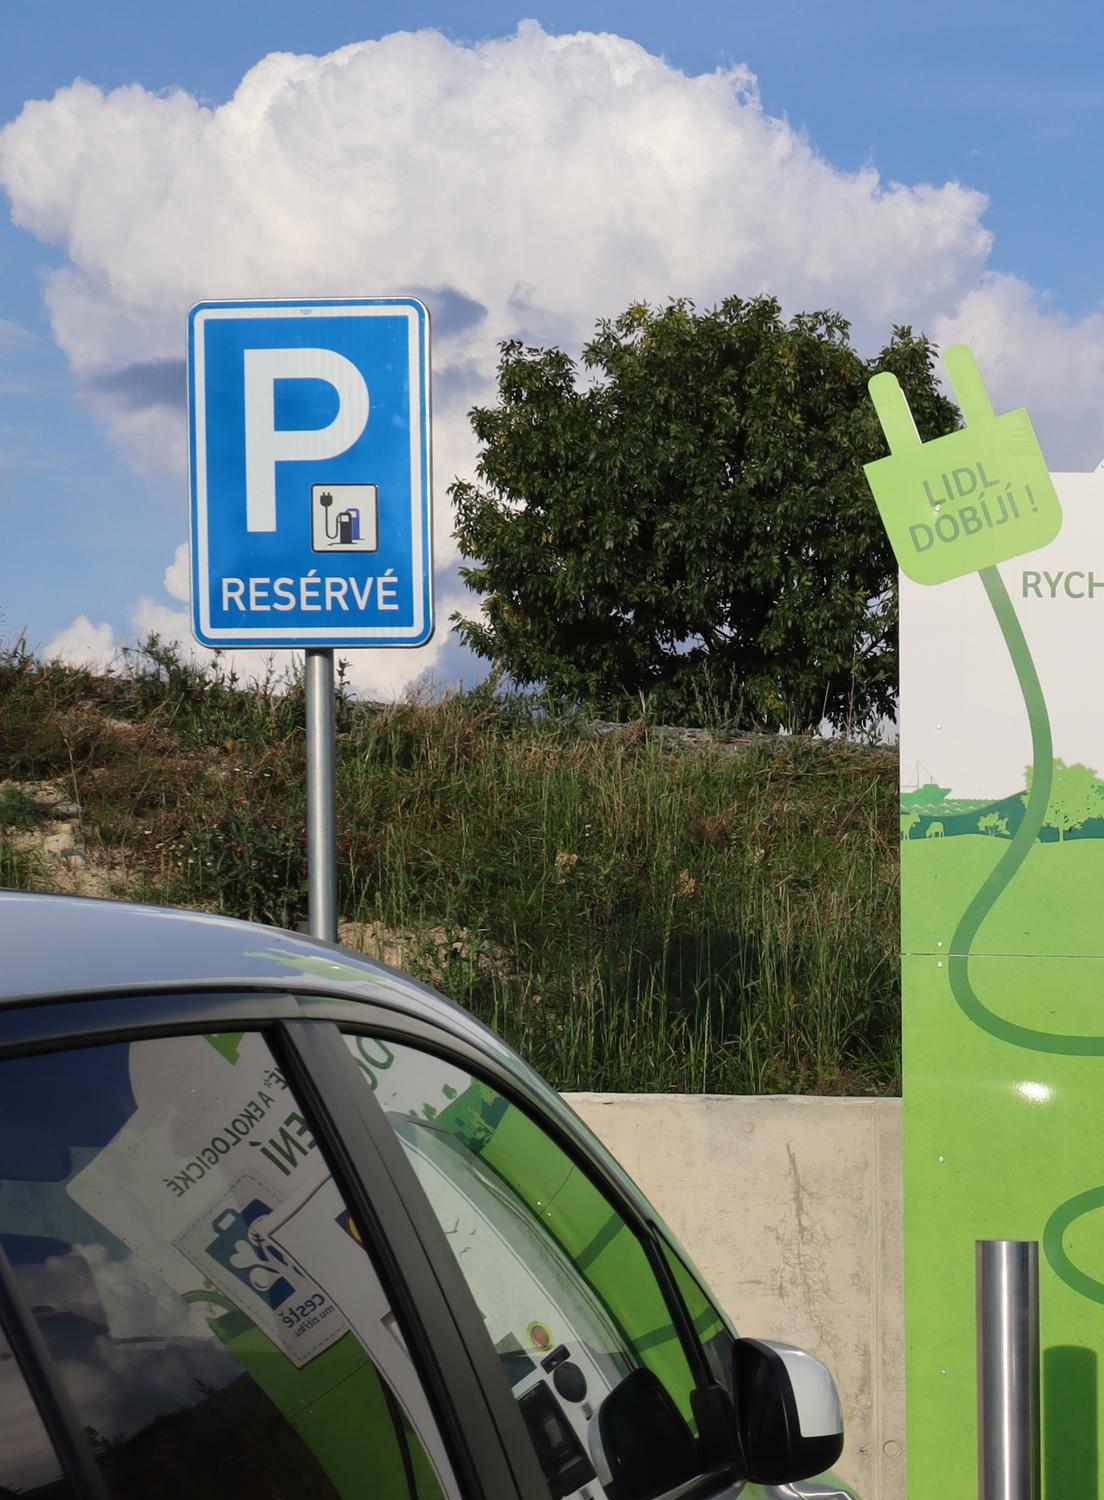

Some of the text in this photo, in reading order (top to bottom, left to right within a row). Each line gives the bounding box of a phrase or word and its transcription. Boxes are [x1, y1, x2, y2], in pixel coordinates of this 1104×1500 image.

[243, 347, 370, 533] P
[922, 460, 1001, 507] LIDL
[908, 481, 1020, 553] DOBÍJÍ
[221, 568, 400, 613] RESÉRVÉ
